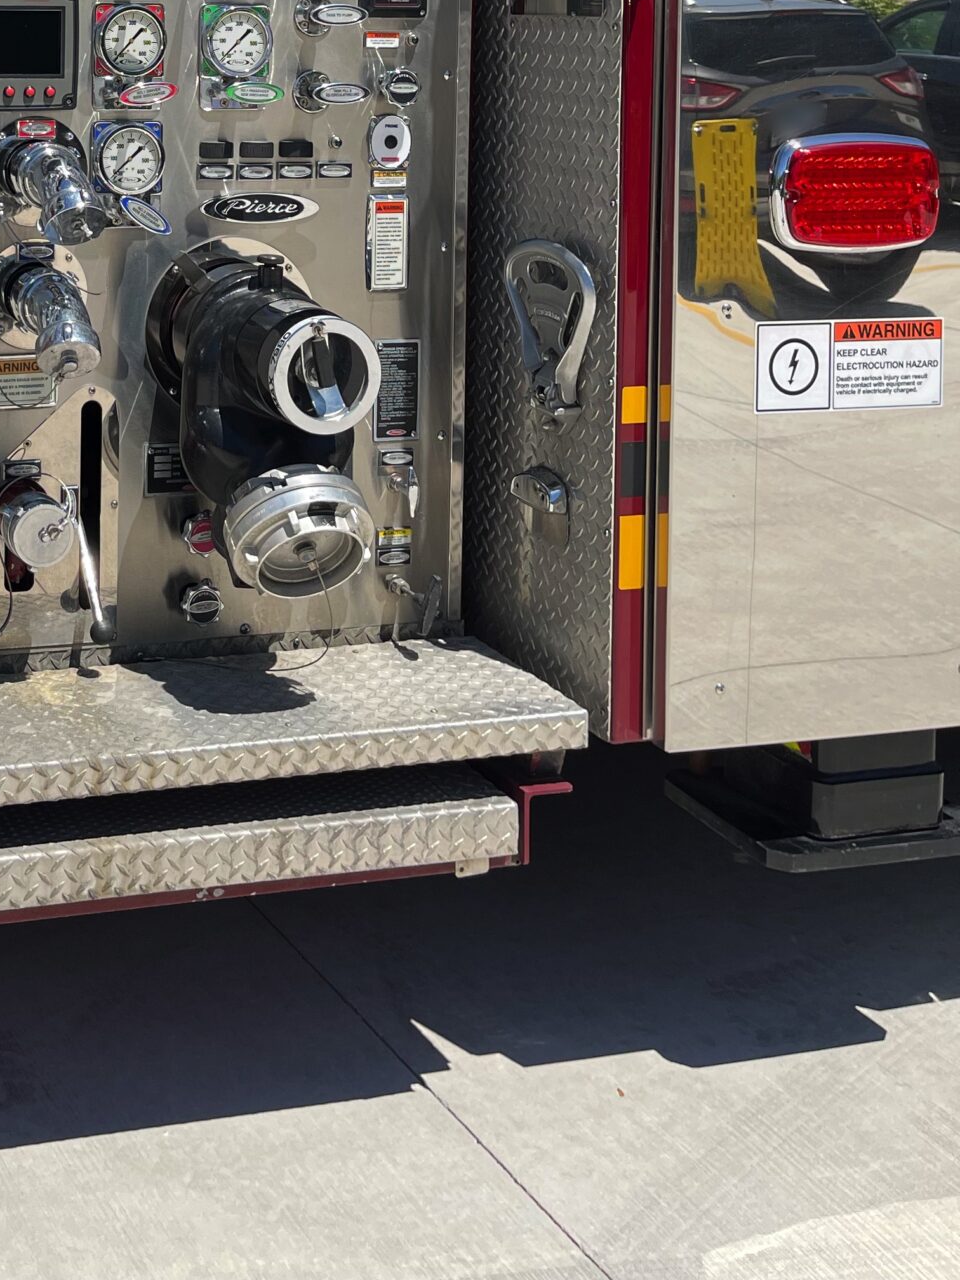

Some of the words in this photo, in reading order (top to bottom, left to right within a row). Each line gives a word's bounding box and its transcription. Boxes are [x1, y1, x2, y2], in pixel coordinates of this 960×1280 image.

[222, 198, 298, 215] Pierce
[858, 322, 934, 339] WARNING
[836, 349, 858, 357] KEEP
[860, 348, 887, 357] CLEAR
[836, 361, 904, 371] ELECTROCUTION
[906, 359, 938, 368] HAZARD
[886, 380, 915, 388] equipment
